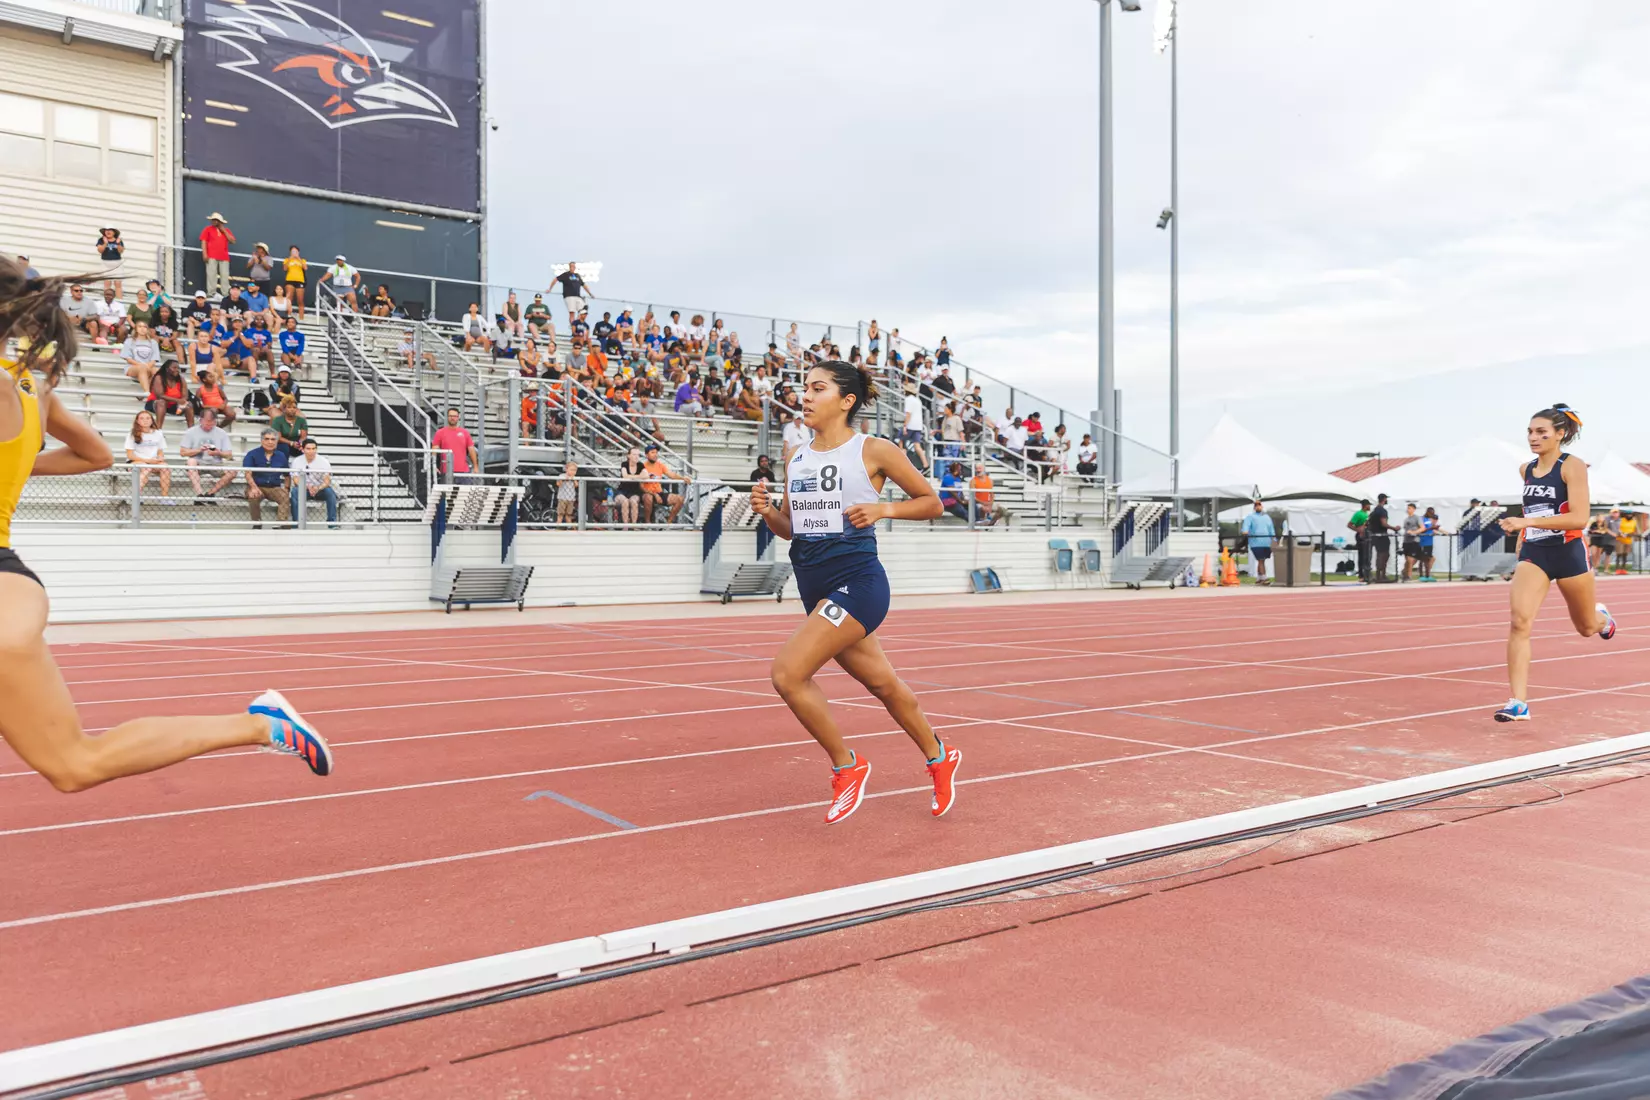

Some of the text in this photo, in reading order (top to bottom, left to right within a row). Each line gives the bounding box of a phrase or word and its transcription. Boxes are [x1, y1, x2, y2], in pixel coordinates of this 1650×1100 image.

[820, 464, 837, 492] 8
[791, 499, 841, 511] Balandran
[803, 518, 829, 530] Alyssa
